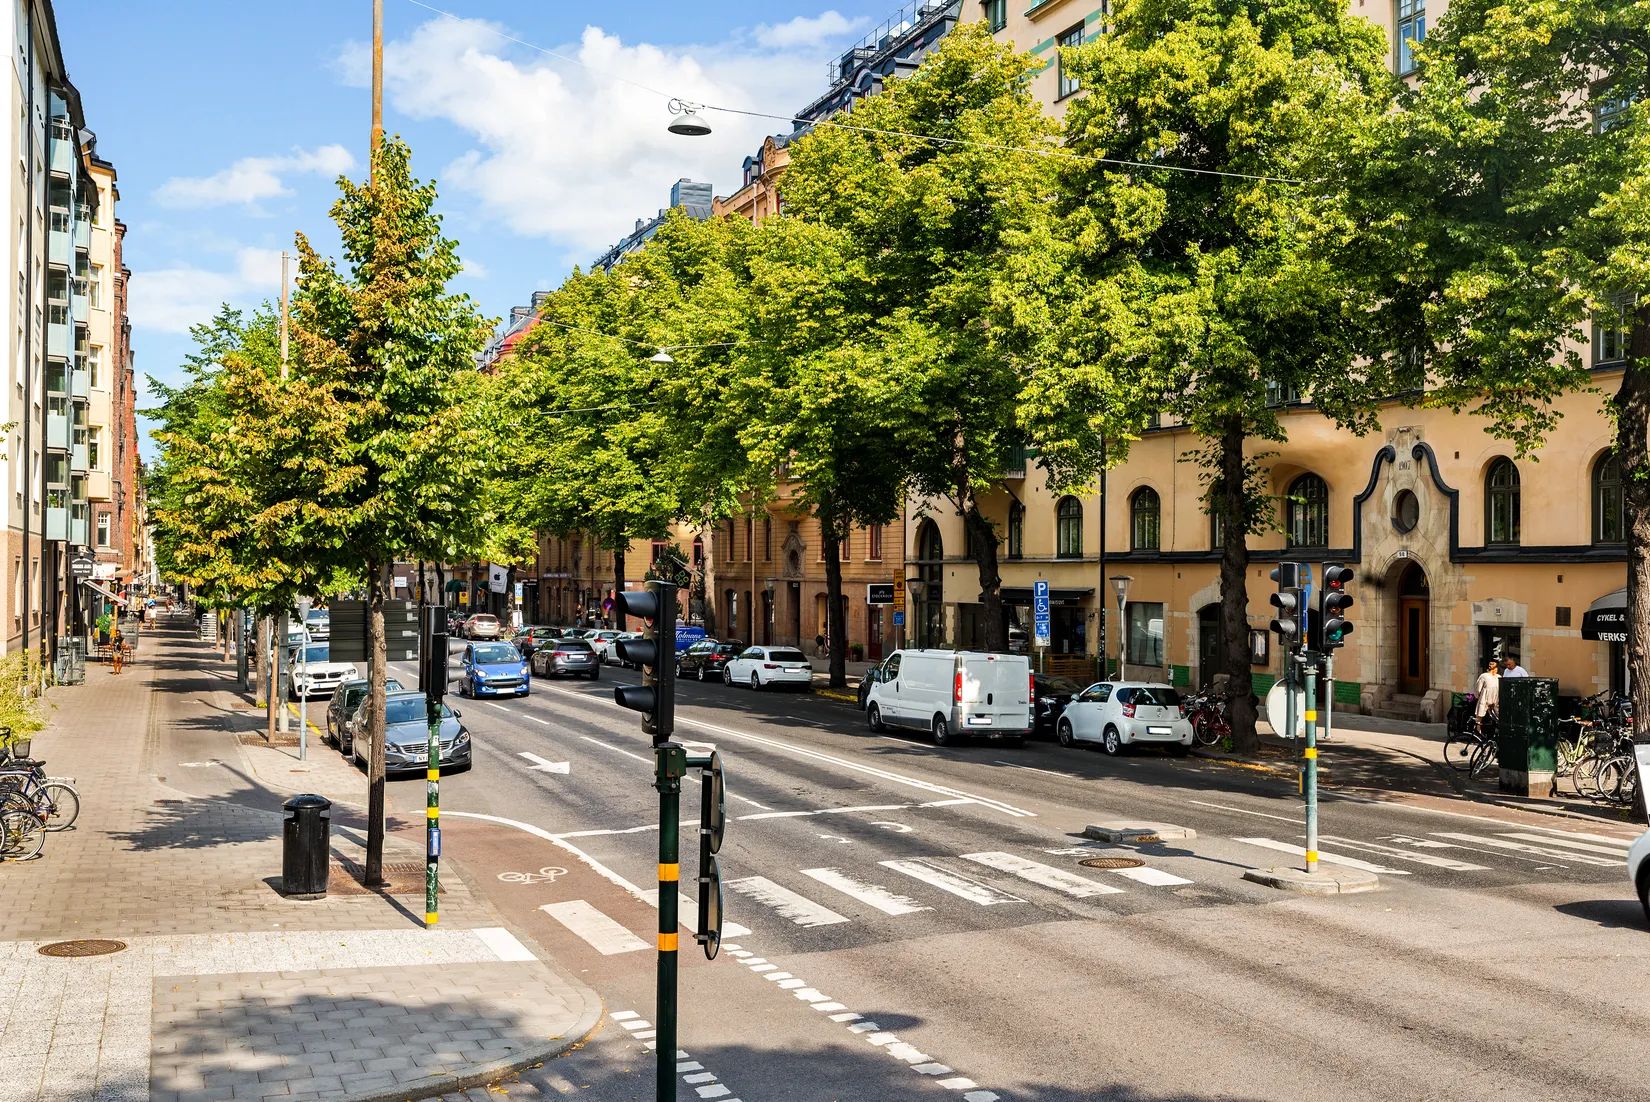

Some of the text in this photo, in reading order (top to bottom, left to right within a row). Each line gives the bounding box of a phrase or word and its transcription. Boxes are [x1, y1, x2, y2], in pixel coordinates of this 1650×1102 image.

[1037, 583, 1046, 596] P
[1596, 614, 1618, 622] CYKEL
[1597, 631, 1628, 642] VERKS
